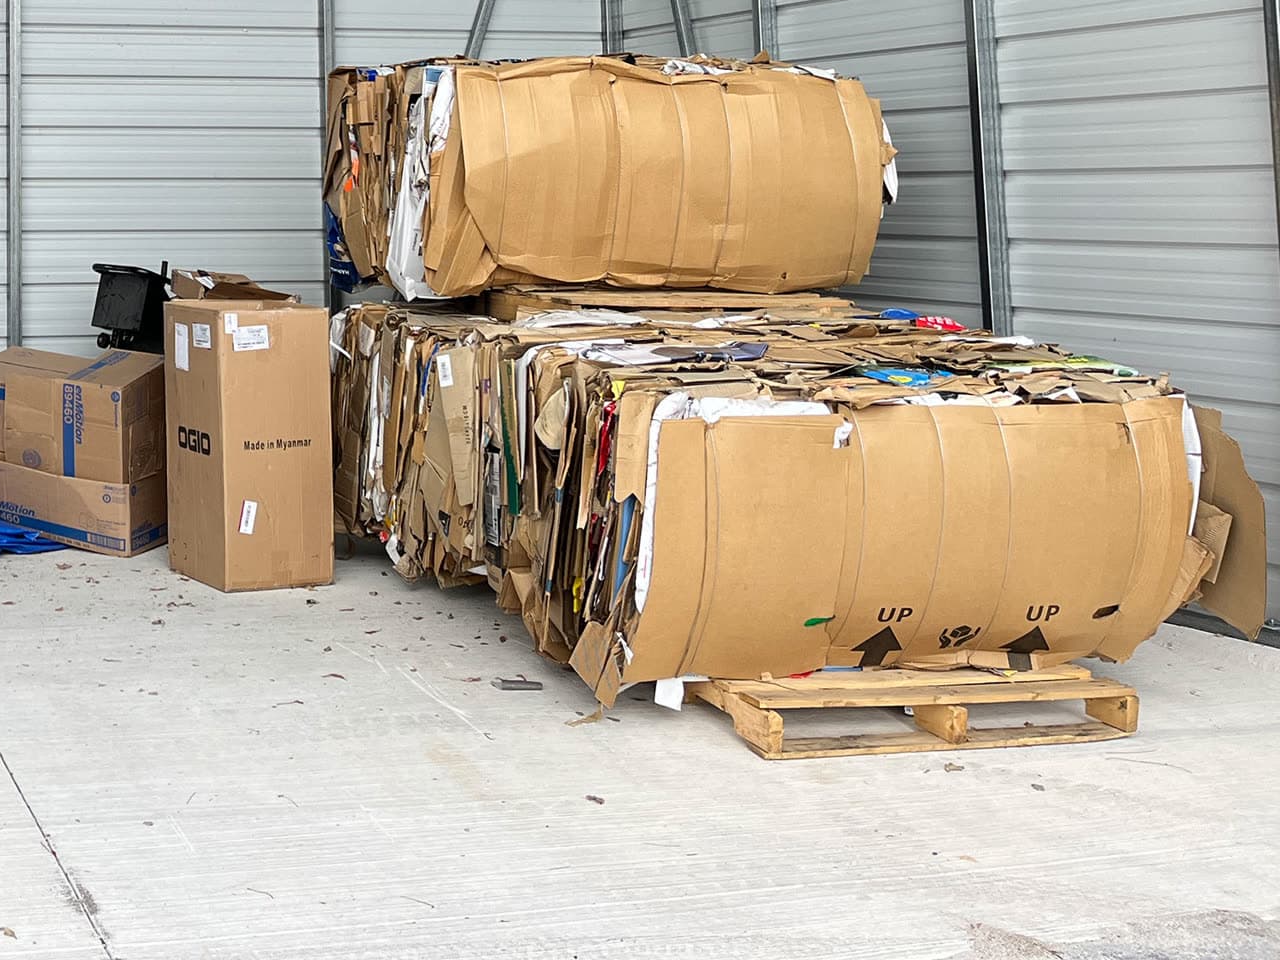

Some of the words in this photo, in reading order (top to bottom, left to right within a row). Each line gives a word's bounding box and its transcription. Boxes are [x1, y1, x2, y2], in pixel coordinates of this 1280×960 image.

[64, 385, 73, 424] 89460
[74, 385, 85, 445] enMotion
[178, 426, 211, 456] OGIO
[243, 440, 265, 450] Made
[267, 440, 274, 449] in
[276, 438, 312, 451] Myanmar
[877, 607, 913, 622] UP
[1026, 605, 1060, 621] UP
